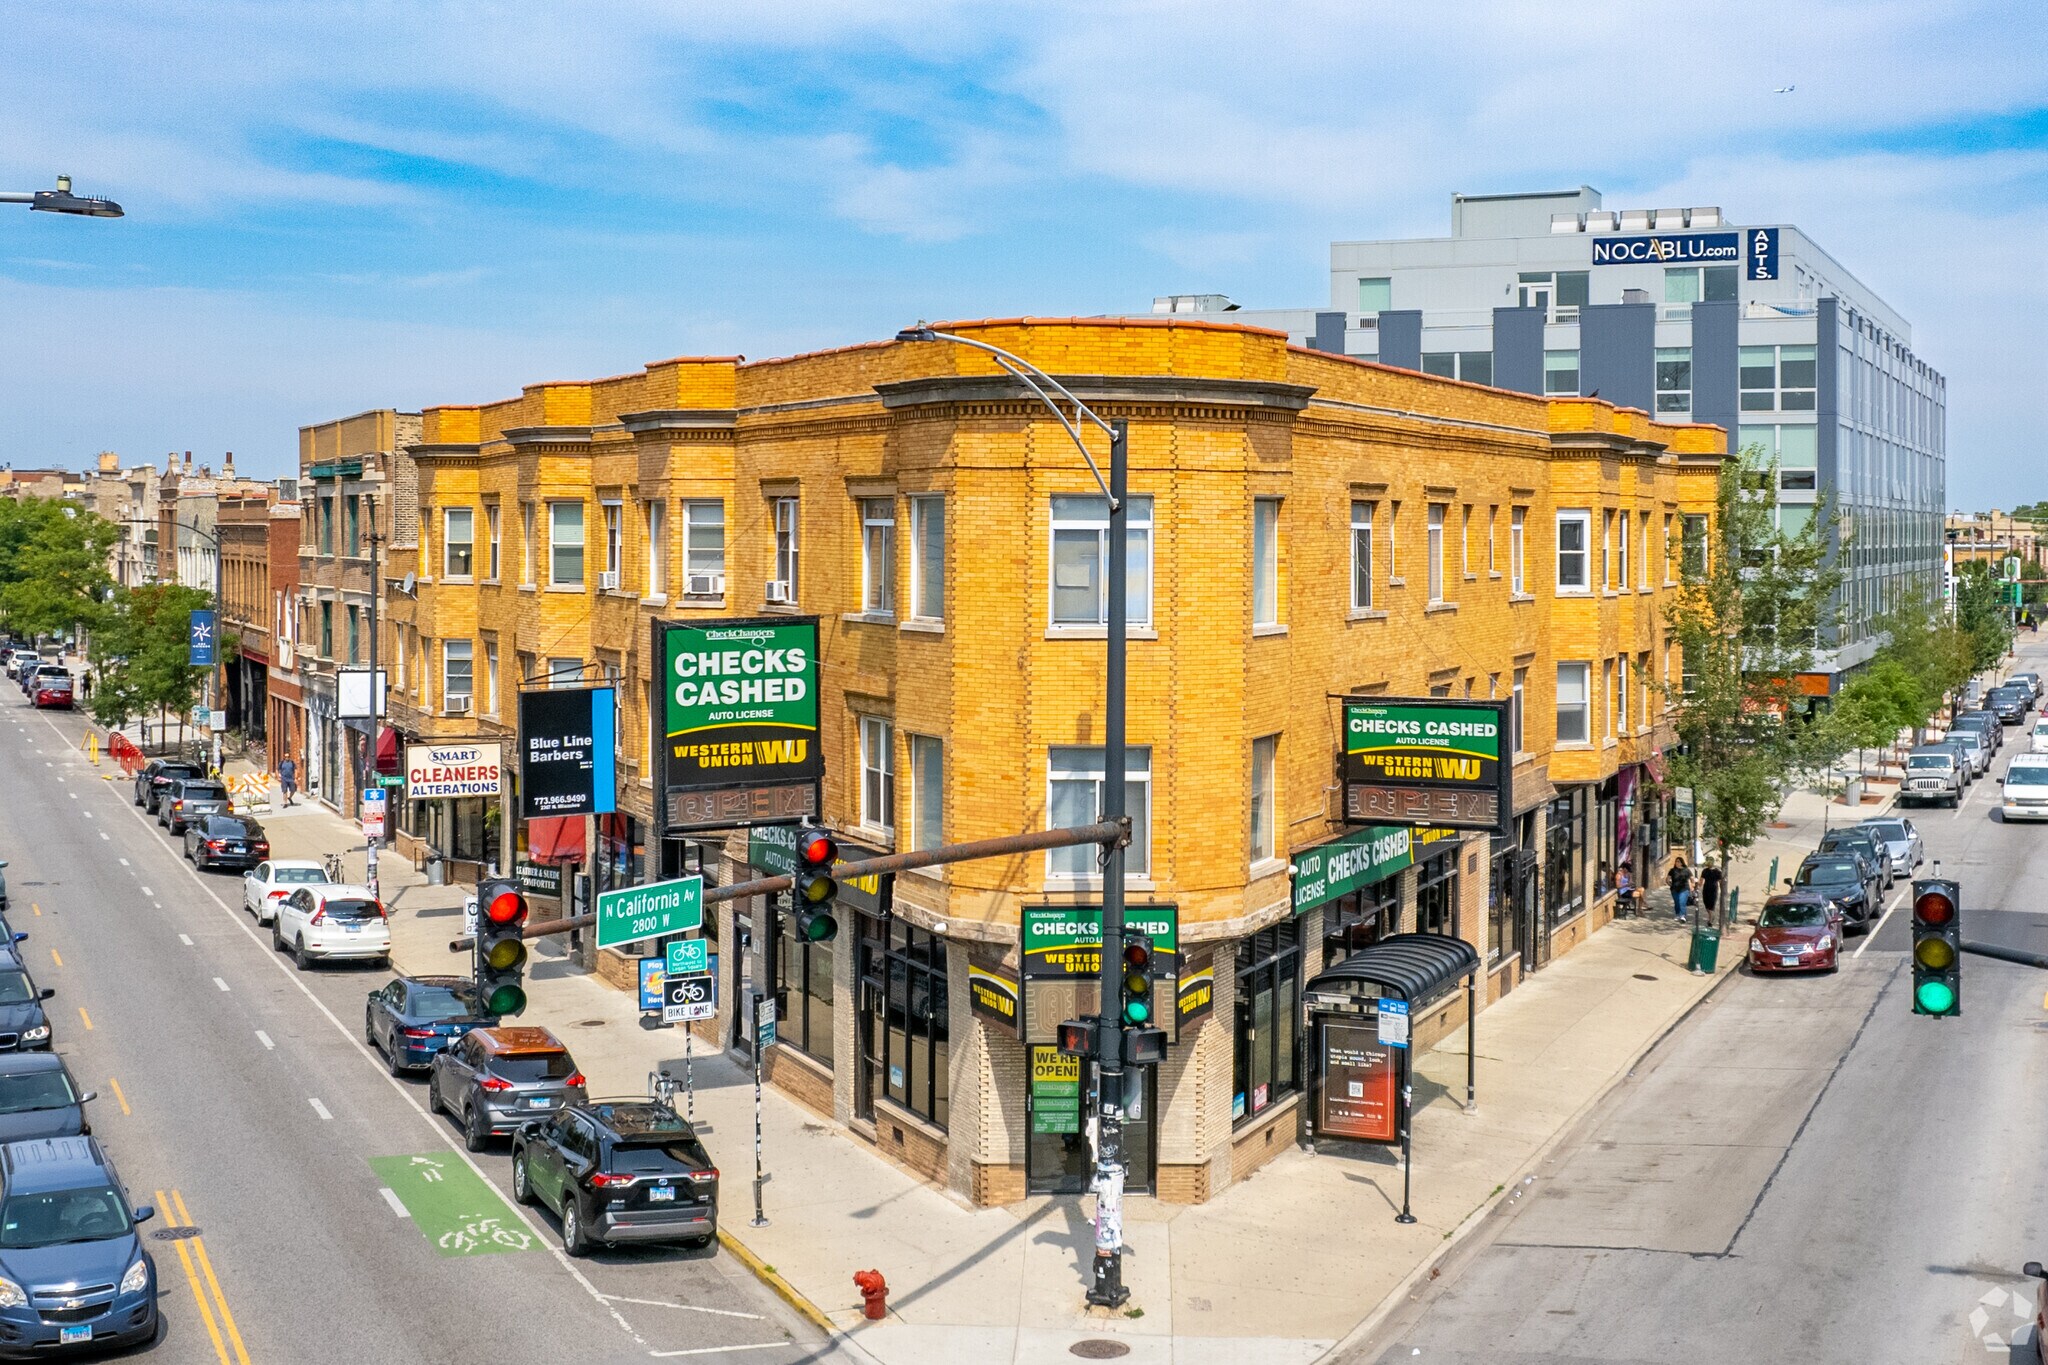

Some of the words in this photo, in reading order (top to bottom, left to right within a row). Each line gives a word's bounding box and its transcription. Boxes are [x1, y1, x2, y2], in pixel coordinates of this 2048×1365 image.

[1594, 238, 1737, 261] NOCABLU.com
[1754, 230, 1773, 280] APTS.
[706, 629, 776, 646] CheckChangers
[674, 648, 807, 678] CHECKS
[675, 678, 807, 707] CASHED
[708, 710, 734, 721] AUTO
[735, 709, 774, 720] LICENSE
[1350, 718, 1421, 734] CHECKS
[1425, 721, 1498, 737] CASHED
[529, 737, 560, 750] Blue
[563, 735, 593, 747] Line
[1395, 736, 1418, 745] AUTO
[1418, 737, 1450, 747] LICENSE
[432, 750, 478, 761] SMART
[529, 749, 584, 763] Barbers
[673, 741, 753, 759] WESTERN
[762, 739, 807, 765] WU
[699, 753, 754, 769] UNION
[1363, 754, 1433, 768] WESTERN
[410, 765, 499, 784] CLEANERS
[1384, 765, 1433, 778] UNION
[1440, 758, 1482, 781] WU
[411, 782, 498, 796] ALTERATIONS
[765, 849, 782, 869] AUTO
[1328, 843, 1370, 885] CHECKS
[1372, 828, 1410, 867] CASHED
[516, 865, 538, 877] LEATHER
[543, 870, 560, 880] SUEDE
[1300, 854, 1321, 879] AUTO
[1295, 878, 1326, 907] LICENSE
[605, 903, 613, 918] N
[616, 888, 680, 919] California
[683, 889, 695, 903] Av
[632, 915, 657, 934] 2800
[662, 913, 670, 927] W
[1031, 922, 1099, 936] CHECKS
[1074, 936, 1095, 944] AUTO
[647, 961, 664, 970] Play
[1045, 953, 1102, 964] WESTER
[1065, 962, 1102, 973] UNIO
[980, 995, 998, 1009] UNION
[667, 1007, 686, 1018] BIKE
[1035, 1065, 1078, 1077] OPEN!
